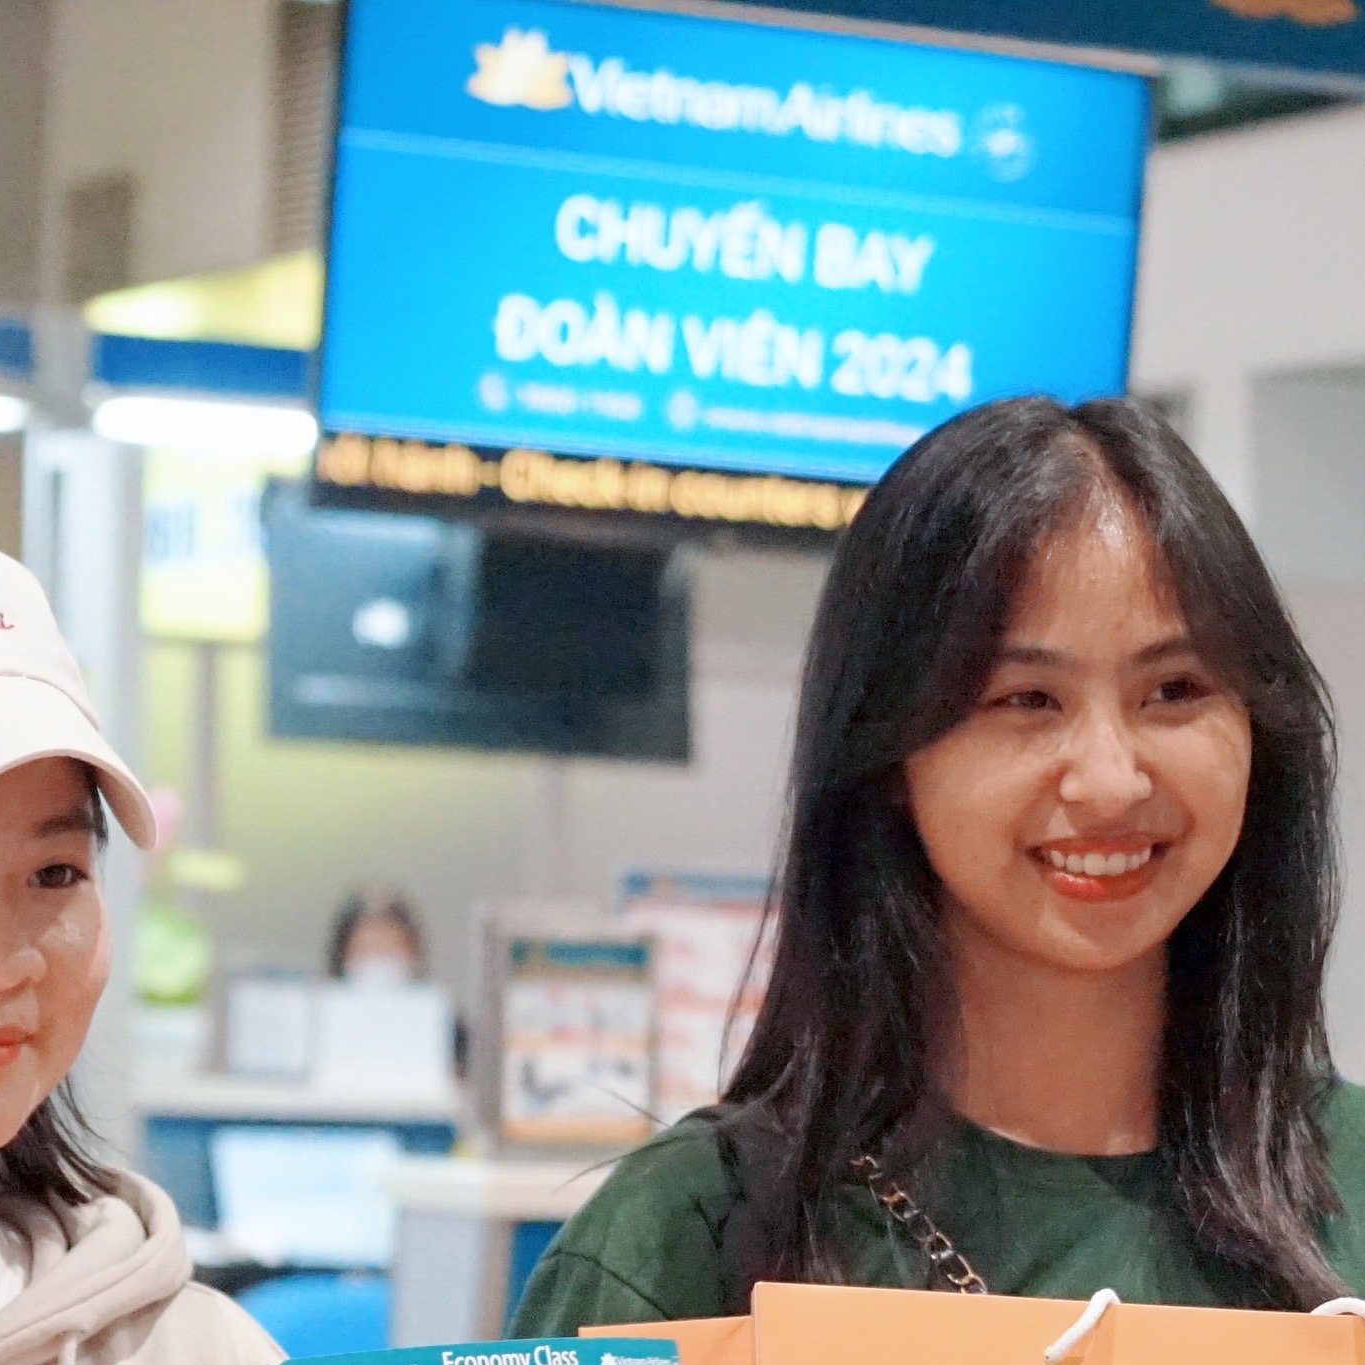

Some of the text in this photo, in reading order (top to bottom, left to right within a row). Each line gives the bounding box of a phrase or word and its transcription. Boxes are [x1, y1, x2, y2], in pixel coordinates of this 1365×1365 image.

[815, 222, 933, 294] BAY
[684, 309, 823, 390] VIÊN
[833, 328, 973, 401] 2024
